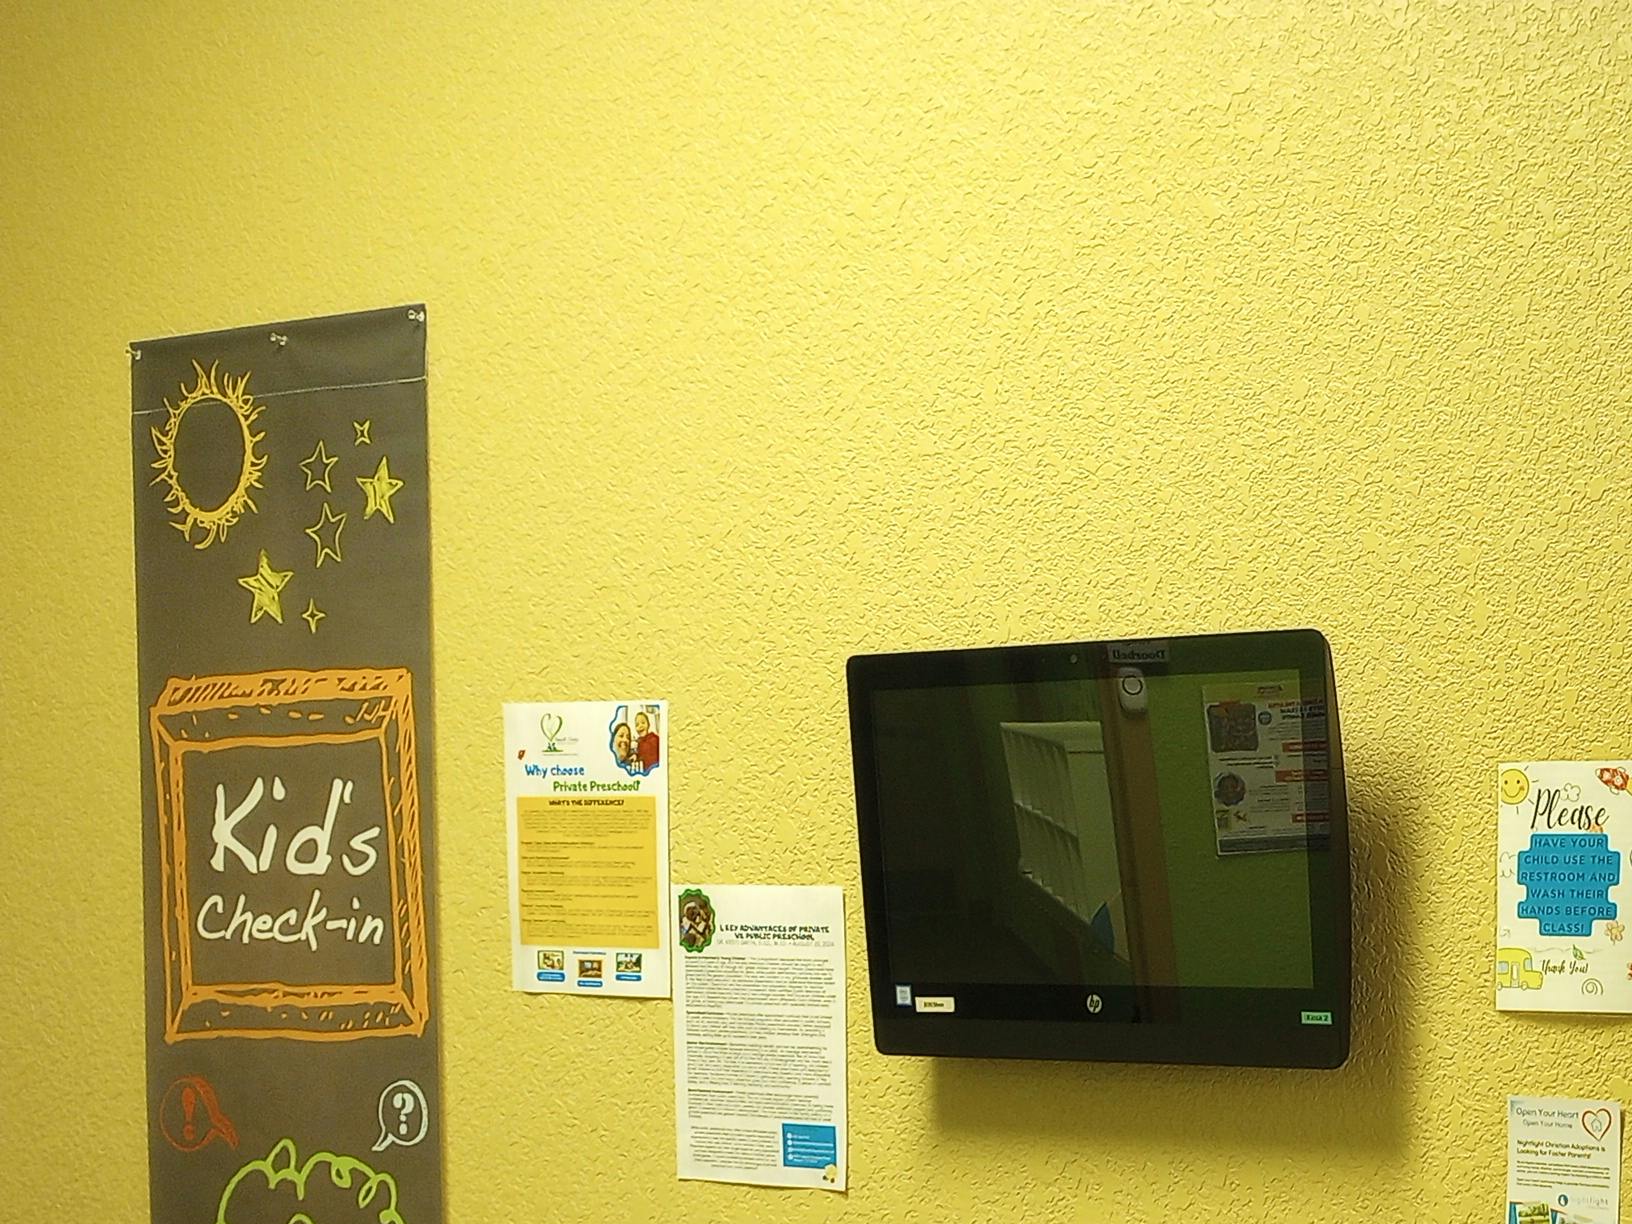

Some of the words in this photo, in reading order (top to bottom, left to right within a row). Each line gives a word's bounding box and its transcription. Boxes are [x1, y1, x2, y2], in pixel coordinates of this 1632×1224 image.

[525, 764, 548, 779] Why
[550, 765, 585, 776] choose
[553, 781, 588, 792] Private
[1530, 786, 1610, 831] Please
[210, 776, 382, 878] Kid's
[1533, 837, 1567, 849] HAVE
[1570, 837, 1605, 850] YOUR
[1523, 854, 1560, 866] CHILD
[1563, 854, 1586, 866] USE
[1590, 854, 1614, 866] THE
[1520, 870, 1585, 882] RESTROOM
[1590, 871, 1617, 883] AND
[1530, 888, 1566, 900] WASH
[1570, 888, 1605, 900] THEIR
[1521, 905, 1561, 917] HANDS
[1565, 905, 1613, 918] BEFORE
[196, 889, 385, 952] Check-in
[1543, 922, 1586, 934] CLASS!
[772, 933, 815, 941] PRESCHOOL
[1516, 1107, 1537, 1117] Open
[1538, 1109, 1556, 1117] Your
[1557, 1110, 1579, 1118] Heart
[1523, 1119, 1539, 1127] Open
